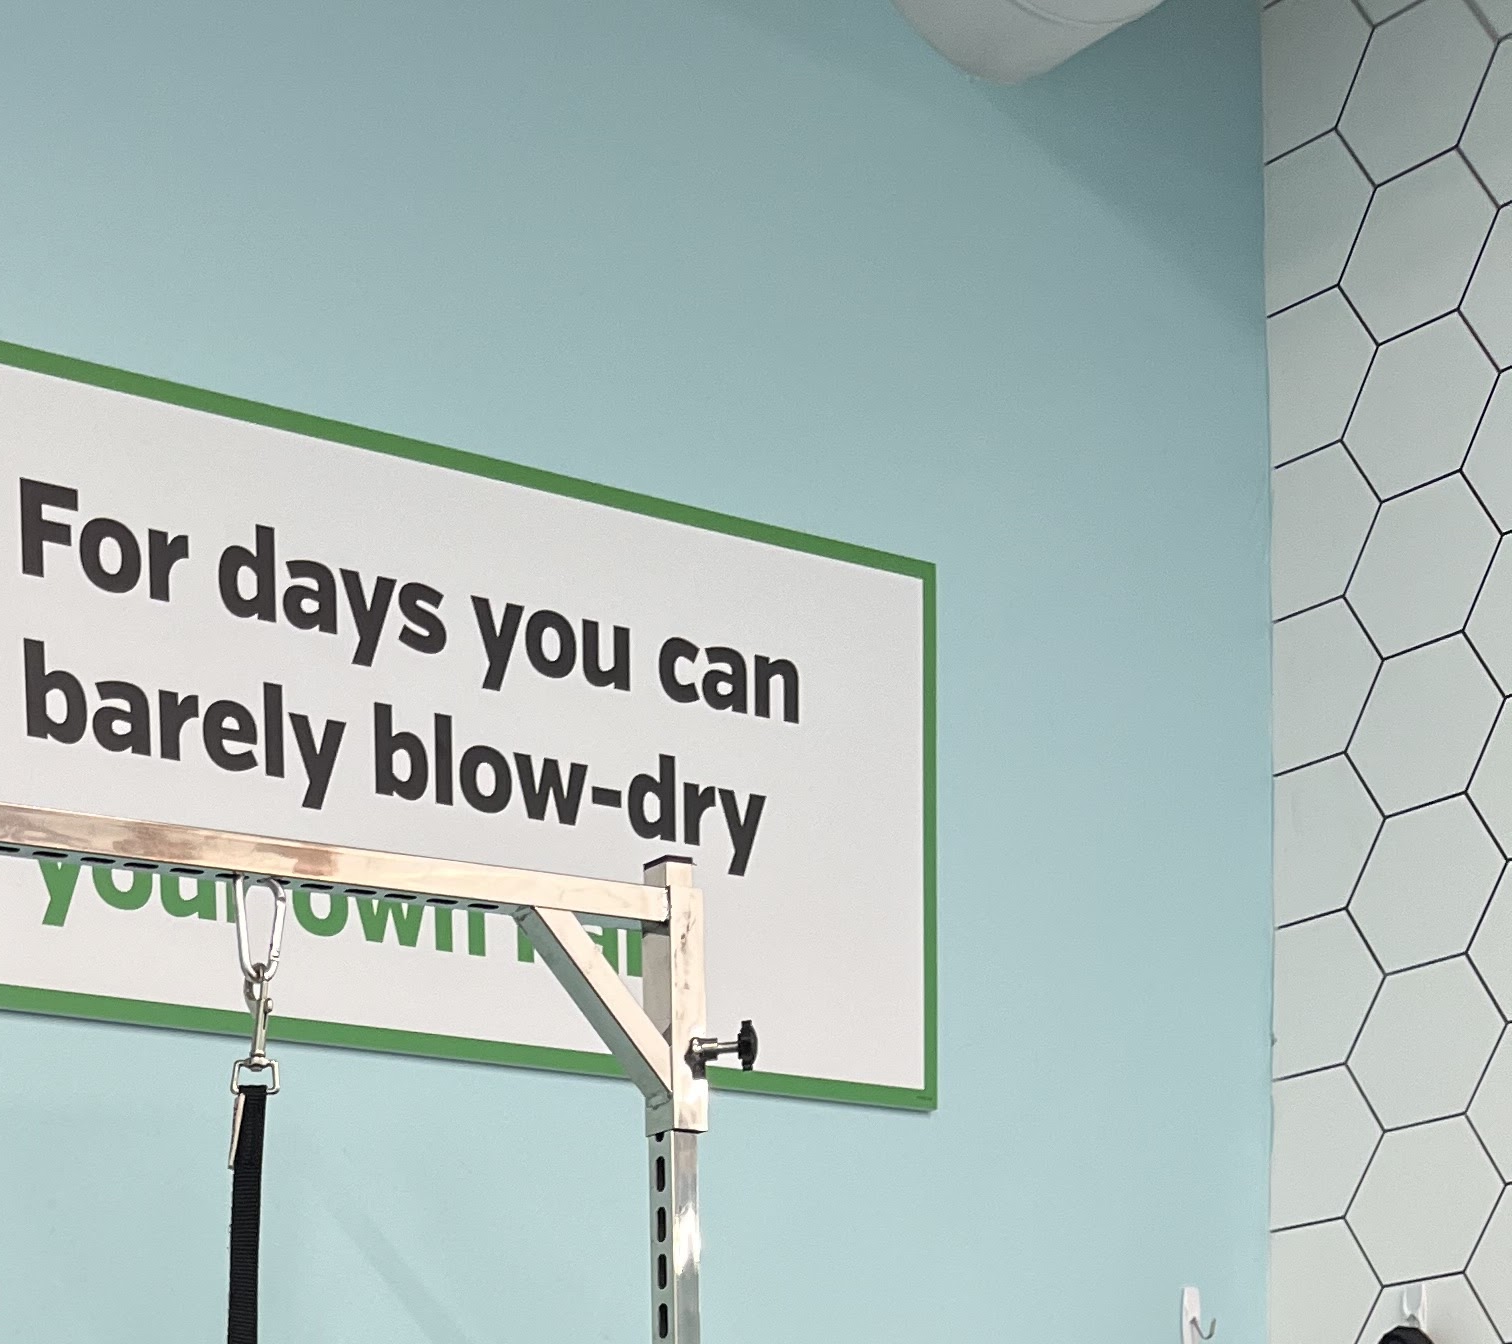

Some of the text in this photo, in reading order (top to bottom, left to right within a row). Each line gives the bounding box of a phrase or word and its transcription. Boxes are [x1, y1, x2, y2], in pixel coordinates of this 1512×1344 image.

[19, 476, 800, 724] For days you can
[23, 637, 767, 877] barely blow-dry
